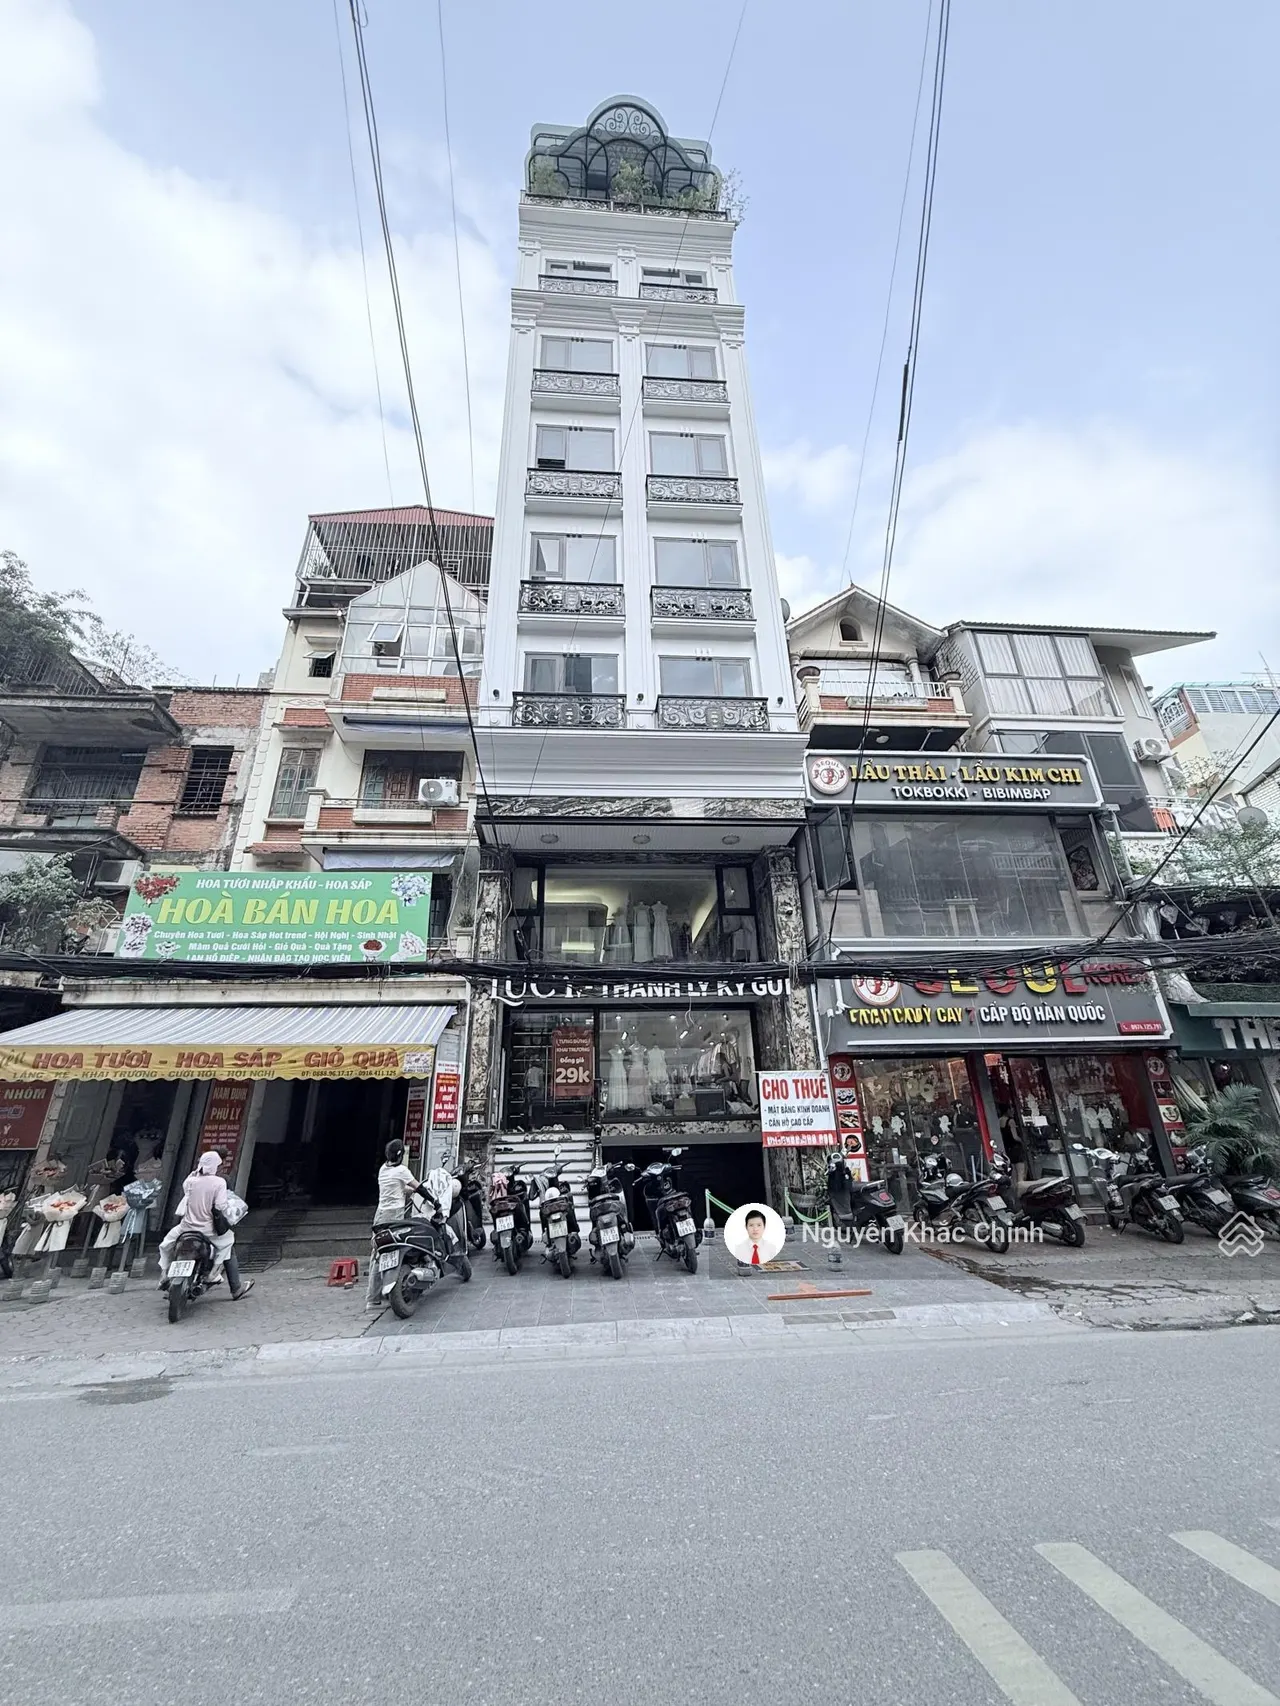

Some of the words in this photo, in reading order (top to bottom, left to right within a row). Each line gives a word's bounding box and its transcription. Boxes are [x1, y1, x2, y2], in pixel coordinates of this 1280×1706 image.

[894, 761, 947, 781] THÁI
[960, 759, 1000, 781] LẨU
[1004, 767, 1045, 782] KIM
[1048, 768, 1083, 783] CHI
[892, 786, 969, 798] TOKBOKKI
[983, 787, 1051, 799] BIBIMBAP
[196, 879, 220, 889] HOA
[223, 878, 250, 889] TƯƠI
[252, 879, 284, 892] NHẬP
[285, 876, 317, 889] KHẨU
[325, 880, 350, 890] HOA
[351, 878, 373, 890] SÁP
[156, 890, 235, 926] HOÀ
[242, 890, 320, 926] BÁN
[325, 899, 399, 926] HOA
[154, 930, 186, 940] Chuyên
[187, 931, 204, 939] Hoa
[232, 931, 249, 939] Hoa
[250, 930, 267, 940] Sáp
[269, 931, 283, 939] Hot
[285, 931, 307, 939] trend
[314, 931, 329, 940] Hội
[330, 931, 349, 940] Nghị
[357, 931, 375, 939] Sinh
[188, 942, 210, 951] Mâm
[332, 942, 353, 952] Tặng
[332, 952, 351, 962] VIÊN
[937, 1007, 962, 1023] CAY
[966, 1008, 975, 1023] 7
[980, 1001, 1008, 1022] CẤP
[1012, 1002, 1032, 1025] ĐỘ
[1034, 1002, 1066, 1022] HÀN
[1068, 1000, 1106, 1021] QUỐC
[32, 1052, 84, 1069] HOA
[94, 1049, 152, 1068] TƯƠI
[175, 1051, 224, 1068] HOA
[232, 1047, 282, 1068] SÁP
[304, 1045, 345, 1068] GIỎ
[352, 1047, 399, 1070] QUÀ
[82, 1070, 108, 1078] KHAI
[247, 1070, 275, 1079] NGHỊ
[555, 1066, 590, 1083] 29k
[762, 1078, 789, 1100] CHO
[792, 1074, 829, 1099] THUÊ
[797, 1105, 811, 1113] KINH
[812, 1105, 831, 1113] DOANH
[791, 1118, 802, 1126] CAO
